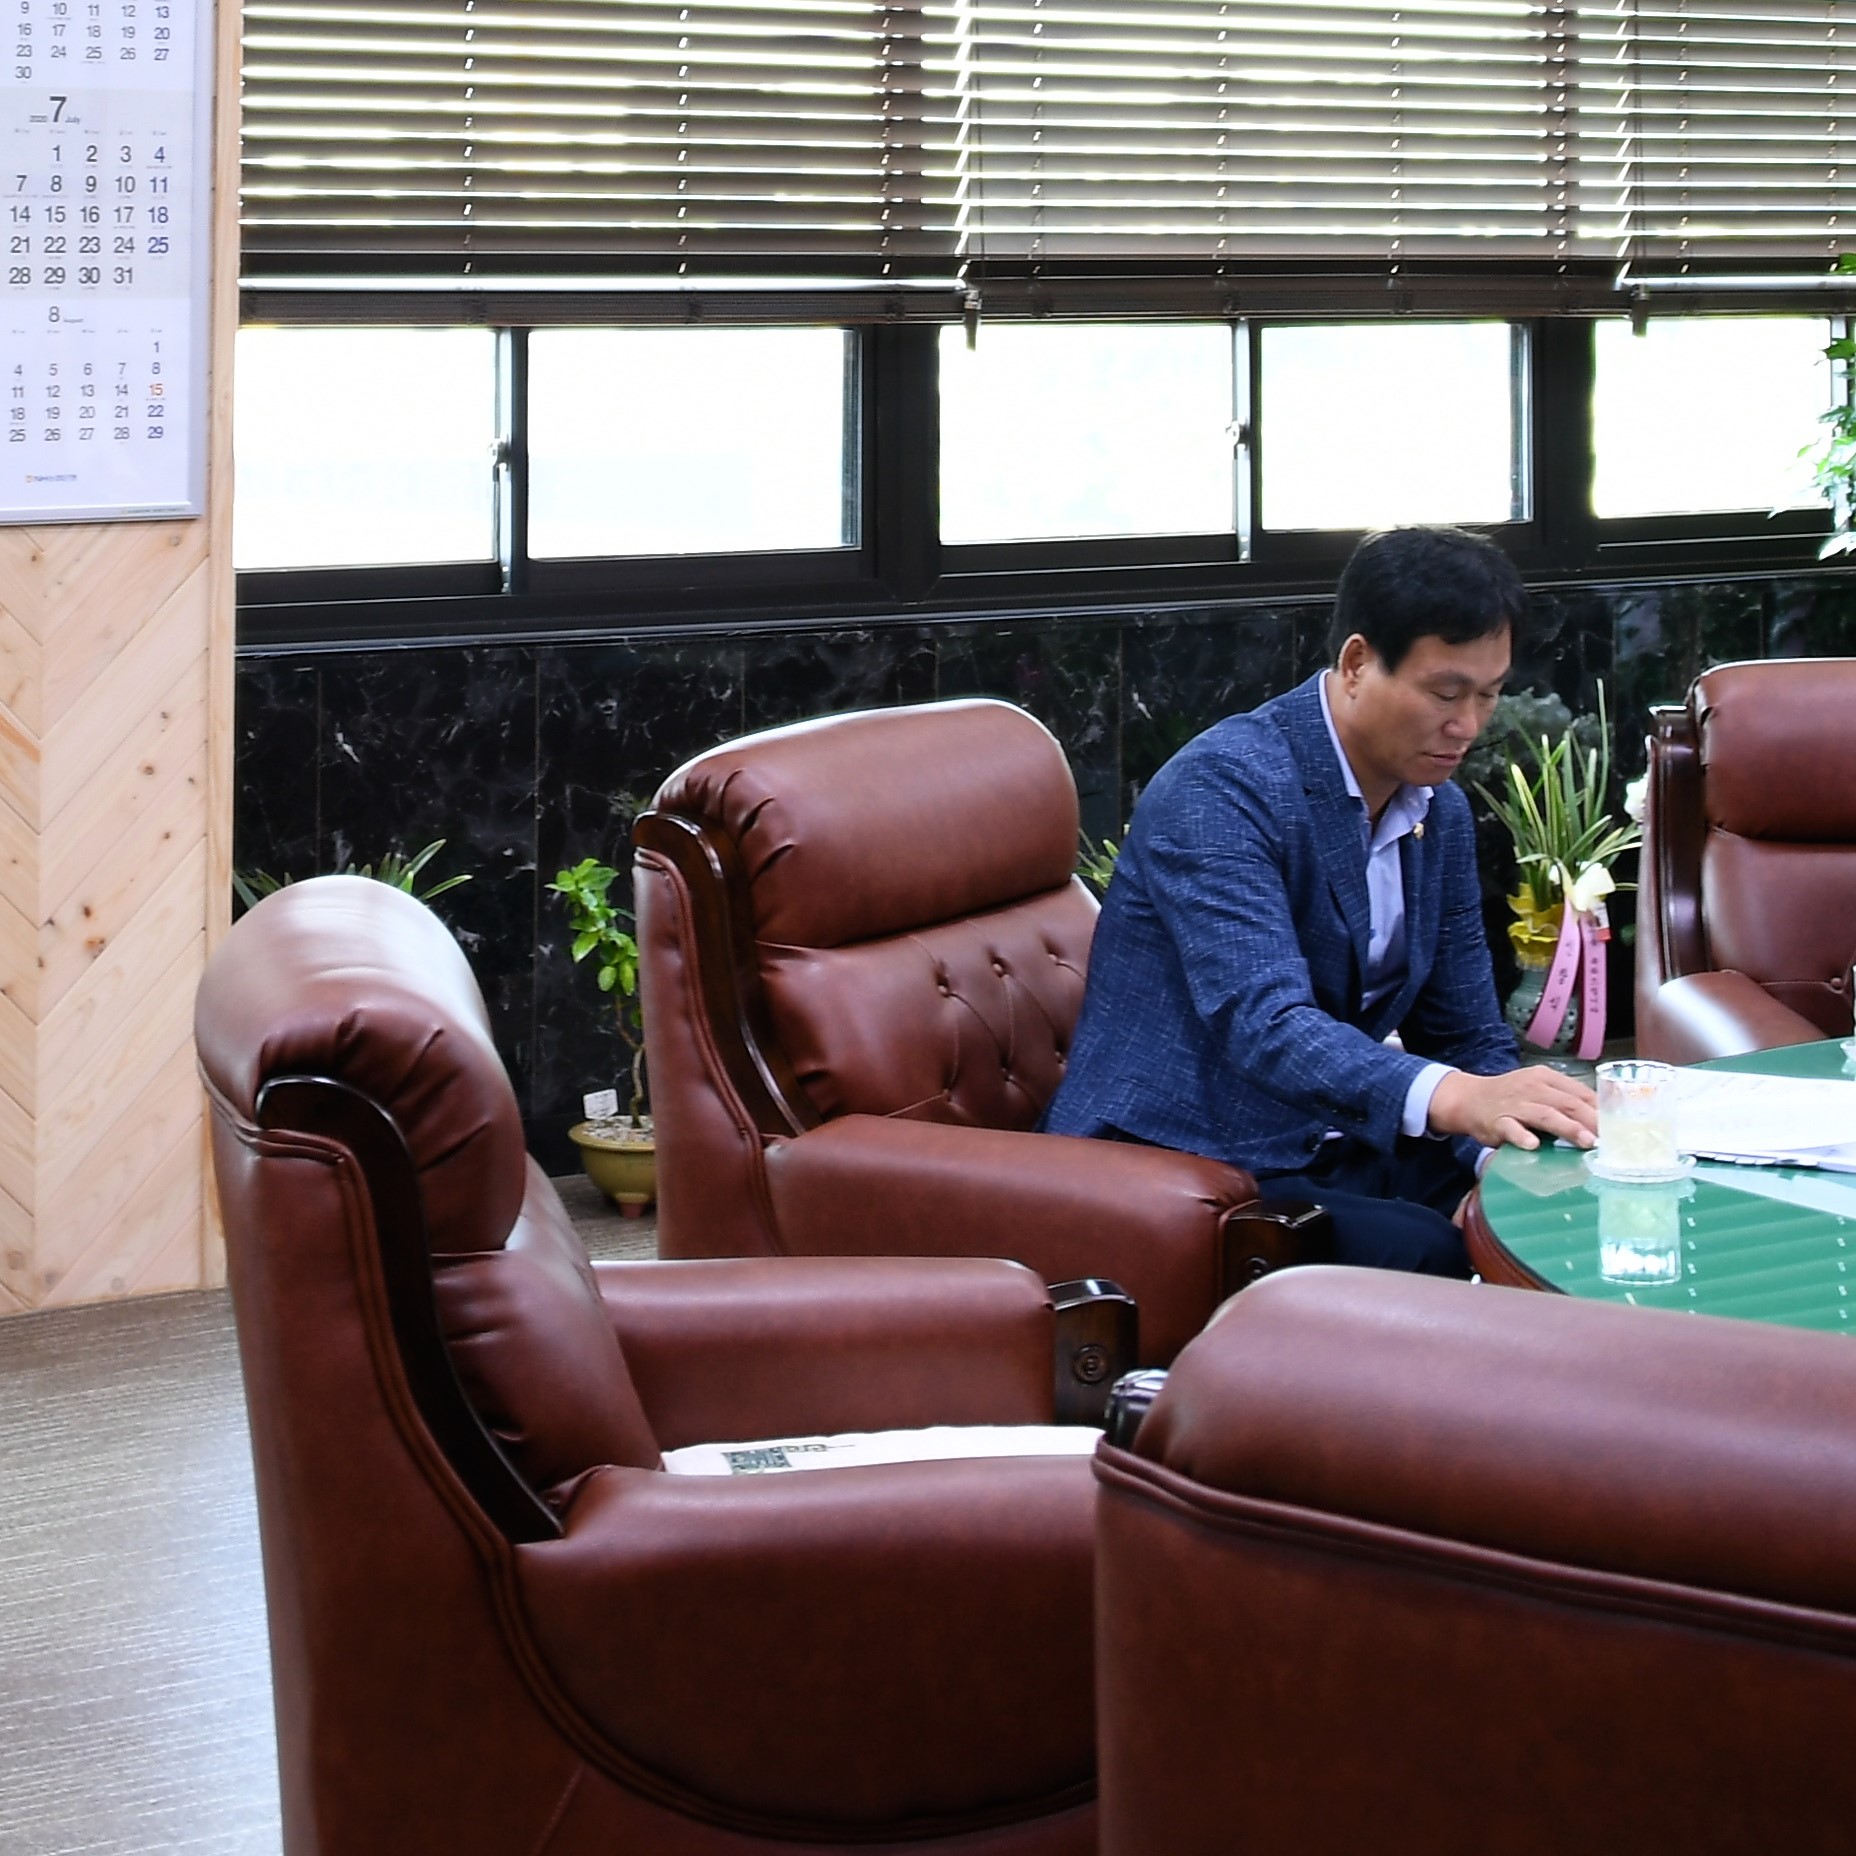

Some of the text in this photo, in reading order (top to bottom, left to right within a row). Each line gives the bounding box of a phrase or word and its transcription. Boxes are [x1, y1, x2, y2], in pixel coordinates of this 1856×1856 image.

[21, 1, 29, 14] 9
[53, 3, 67, 15] 10
[88, 4, 99, 16] 11
[121, 5, 135, 17] 12
[156, 6, 169, 18] 13
[18, 23, 32, 35] 16
[52, 24, 66, 36] 17
[87, 25, 101, 38] 18
[122, 26, 135, 39] 19
[154, 27, 170, 39] 20
[16, 44, 32, 57] 23
[51, 45, 66, 58] 24
[86, 46, 102, 59] 25
[120, 47, 136, 60] 26
[154, 48, 169, 60] 27
[15, 66, 32, 79] 30
[49, 96, 67, 123] 7
[53, 145, 165, 163] 1 2 3 4
[17, 175, 27, 191] 7
[51, 175, 62, 192] 8
[86, 176, 97, 192] 9
[116, 176, 136, 193] 10
[150, 177, 167, 193] 11
[10, 206, 31, 222] 14
[45, 206, 65, 223] 15
[81, 206, 100, 223] 16
[114, 206, 134, 223] 17
[148, 206, 168, 223] 18
[11, 236, 30, 253] 21
[44, 236, 66, 253] 22
[79, 236, 101, 253] 23
[114, 237, 135, 253] 24
[148, 237, 169, 253] 25
[9, 267, 31, 284] 28
[44, 267, 65, 284] 29
[79, 267, 100, 284] 30
[114, 267, 132, 284] 31
[49, 306, 60, 322] 8
[154, 342, 159, 352] 1
[14, 365, 22, 375] 4
[50, 363, 58, 376] 5
[84, 363, 92, 375] 6
[118, 362, 126, 374] 7
[152, 362, 160, 374] 8
[12, 386, 24, 398] 11
[46, 385, 60, 398] 12
[81, 384, 95, 397] 13
[115, 384, 128, 396] 14
[150, 383, 163, 396] 15
[11, 407, 25, 420] 18
[46, 407, 60, 419] 19
[79, 406, 95, 418] 20
[115, 406, 128, 418] 21
[148, 405, 164, 417] 22
[10, 429, 26, 442] 25
[45, 428, 60, 441] 26
[79, 428, 94, 440] 27
[114, 427, 130, 439] 28
[148, 426, 163, 439] 29
